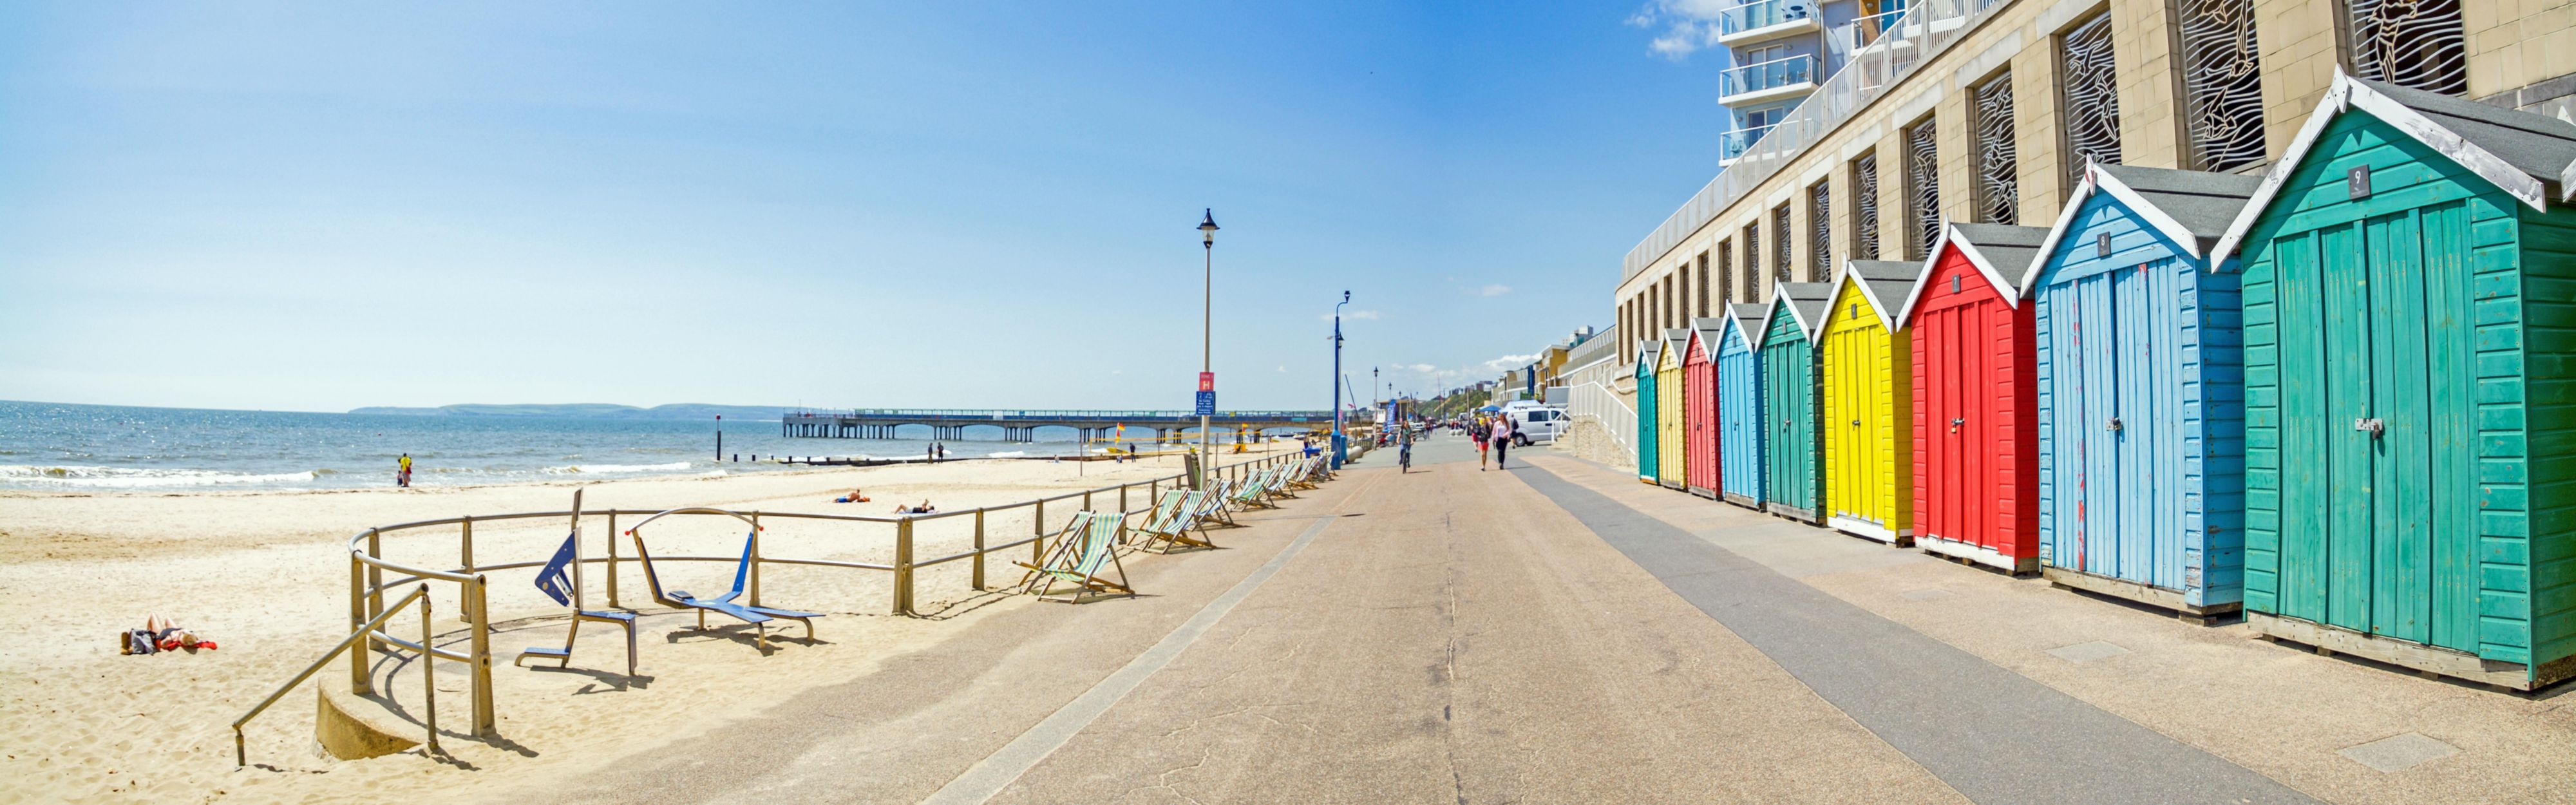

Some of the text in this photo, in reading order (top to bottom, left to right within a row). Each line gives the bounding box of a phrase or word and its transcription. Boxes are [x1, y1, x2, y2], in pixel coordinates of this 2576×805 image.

[2355, 170, 2361, 184] 9
[2101, 236, 2105, 245] 8
[1202, 381, 1210, 390] H
